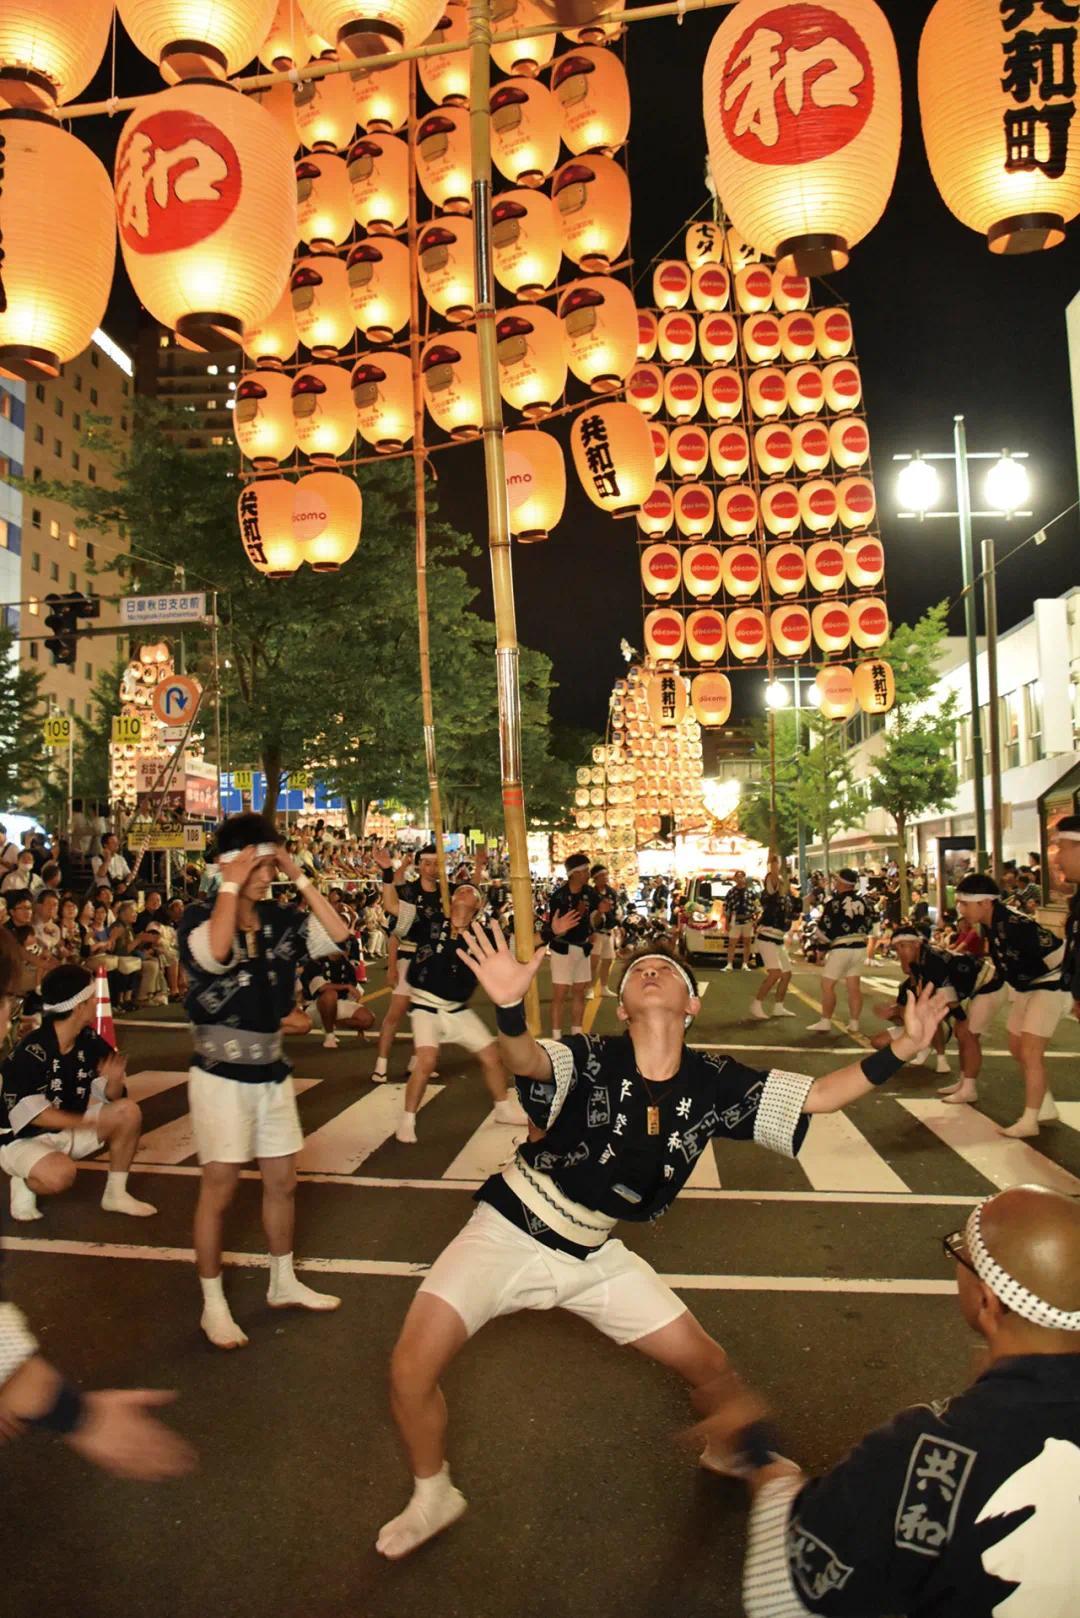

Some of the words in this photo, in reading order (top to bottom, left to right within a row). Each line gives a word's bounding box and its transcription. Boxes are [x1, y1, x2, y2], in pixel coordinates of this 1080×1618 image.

[696, 224, 716, 256] 七夕
[581, 415, 620, 498] 共和町
[662, 677, 675, 718] 共和町
[872, 665, 887, 706] 共和町
[47, 720, 71, 736] 109
[116, 718, 141, 735] 110
[664, 1097, 692, 1180] 共和町
[899, 1448, 959, 1545] 共和
